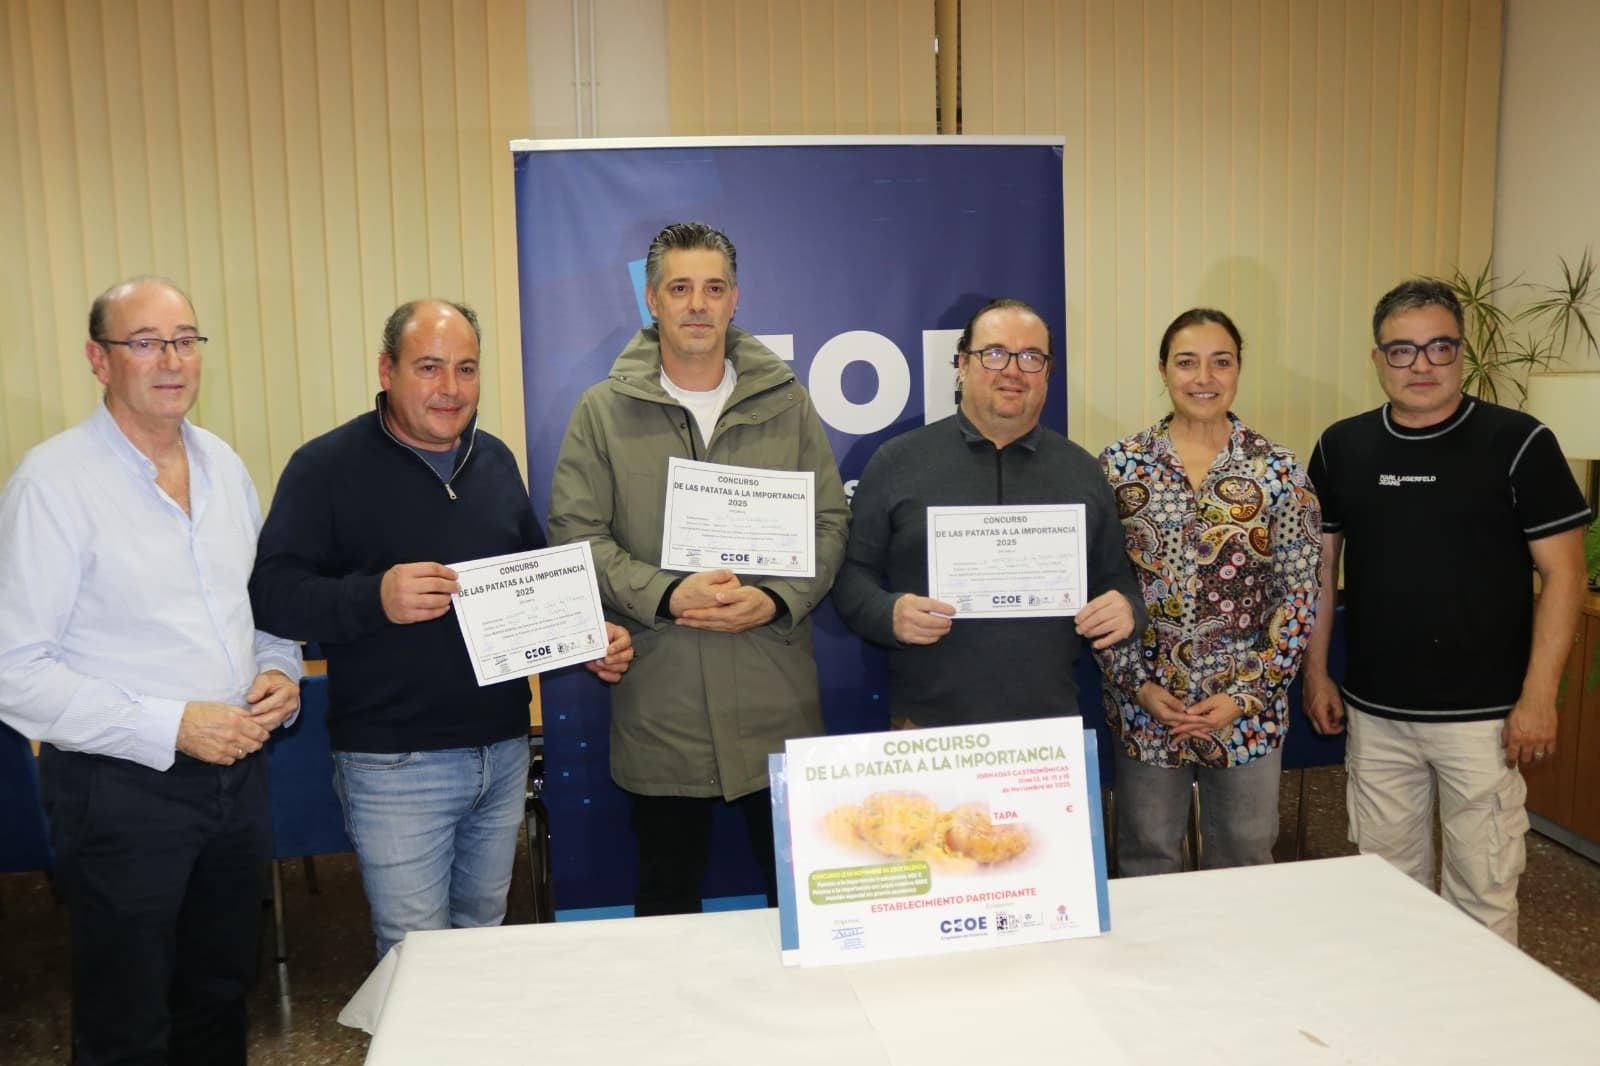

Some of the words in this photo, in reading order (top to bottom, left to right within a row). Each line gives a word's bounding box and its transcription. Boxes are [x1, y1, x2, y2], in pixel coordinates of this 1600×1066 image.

[718, 476, 759, 486] CONCURSO
[685, 484, 699, 492] LAS
[700, 486, 732, 496] PATATAS
[753, 491, 805, 500] IMPORTANCIA
[728, 499, 748, 507] 2025
[983, 516, 1028, 524] CONCURSO
[936, 530, 946, 538] DE
[965, 529, 1000, 537] PATATAS
[1021, 526, 1076, 535] IMPORTANCIA
[500, 561, 539, 575] CONCURSO
[459, 590, 469, 598] DE
[470, 586, 484, 595] LAS
[486, 579, 517, 592] PATATAS
[519, 577, 525, 585] A
[525, 575, 535, 584] LA
[535, 564, 585, 581] IMPORTANCIA
[515, 587, 535, 598] 2025
[883, 733, 990, 756] CONCURSO
[805, 766, 827, 782] DE
[832, 764, 850, 779] LA
[856, 758, 913, 777] PATATA
[917, 759, 929, 771] A
[932, 755, 951, 771] LA
[956, 746, 1066, 769] IMPORTANCIA
[993, 811, 1018, 821] TAPA
[1066, 804, 1073, 813] €
[871, 895, 964, 913] ESTABLECIMIENTO
[966, 887, 1037, 903] PARTICIPANTE
[940, 916, 987, 934] CEOE
